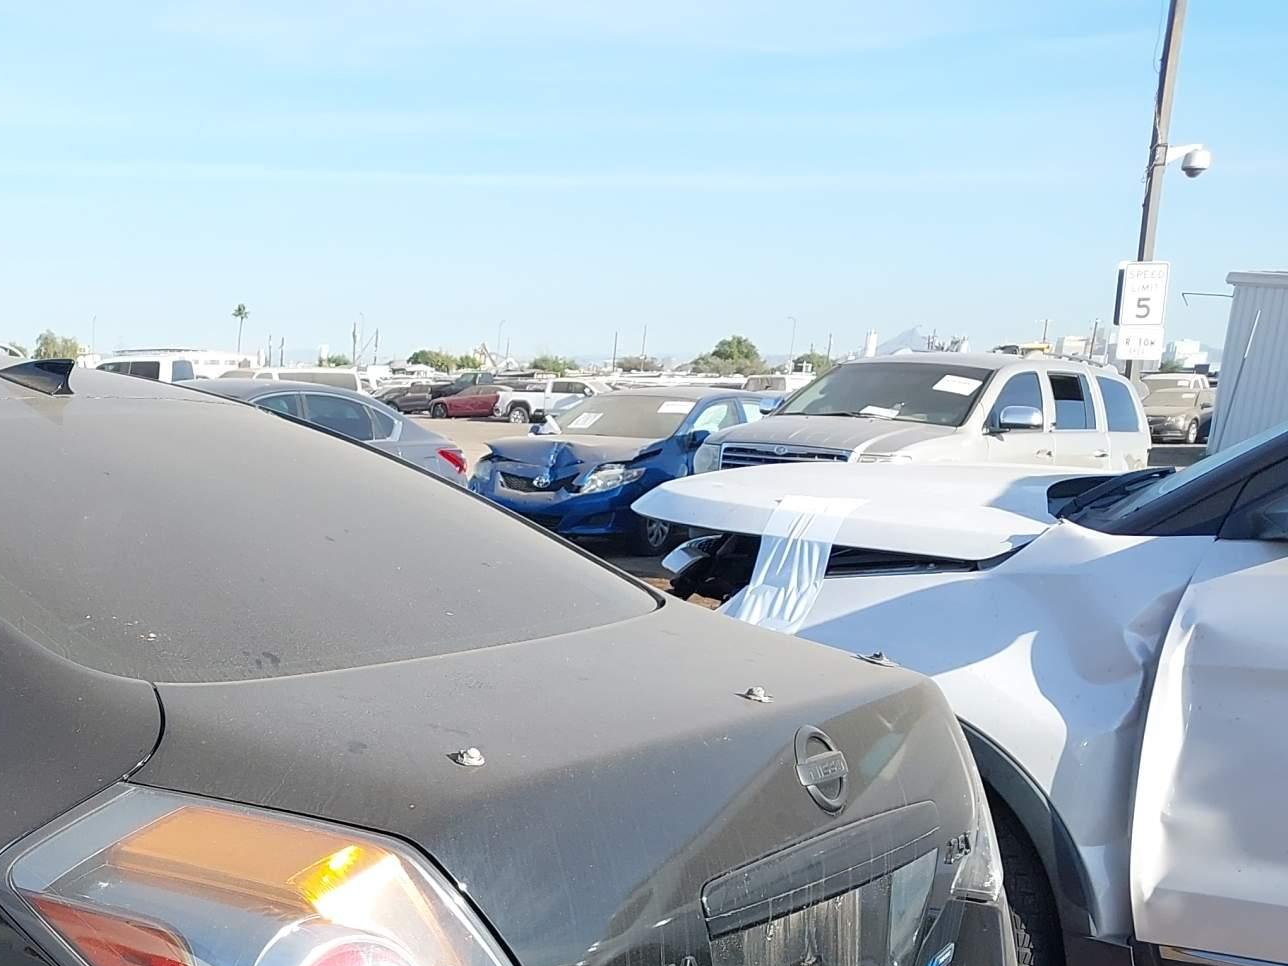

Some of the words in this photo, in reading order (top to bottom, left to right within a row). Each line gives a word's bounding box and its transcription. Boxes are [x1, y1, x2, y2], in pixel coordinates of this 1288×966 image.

[1128, 269, 1165, 280] SPEED
[1131, 283, 1159, 293] LIMIT
[1135, 297, 1151, 319] 5
